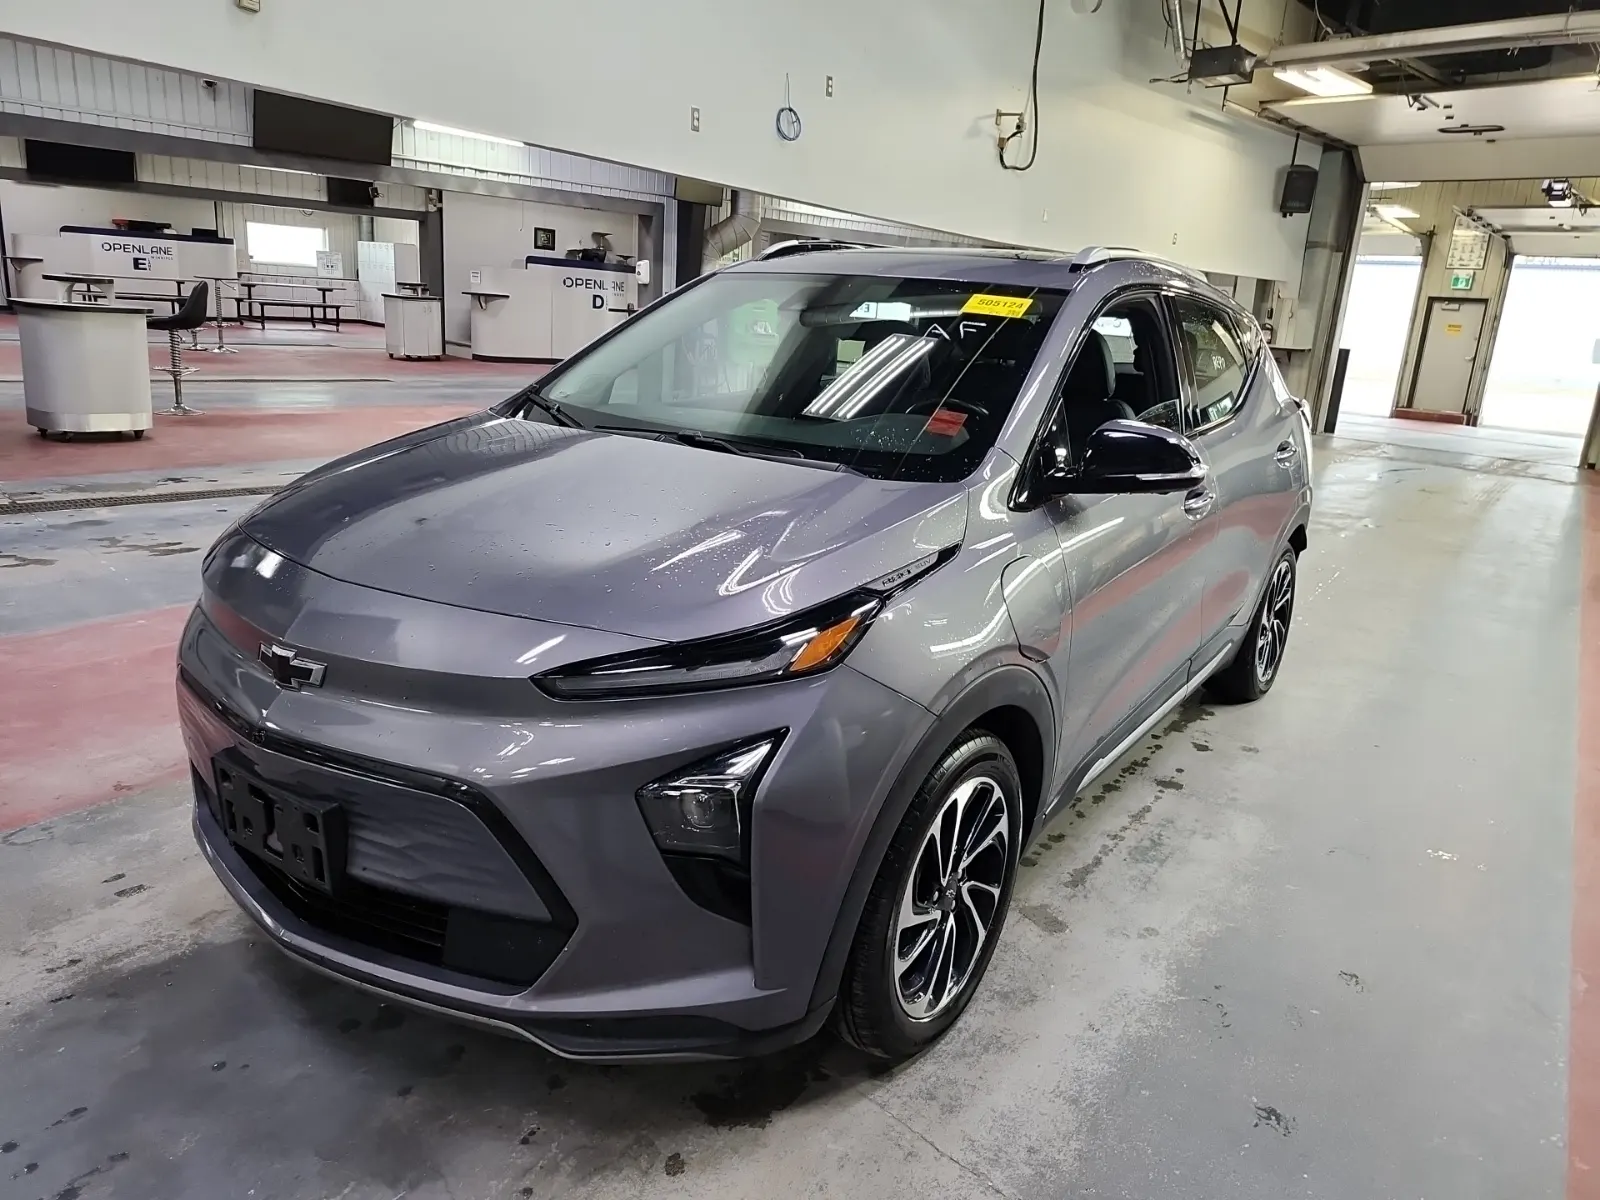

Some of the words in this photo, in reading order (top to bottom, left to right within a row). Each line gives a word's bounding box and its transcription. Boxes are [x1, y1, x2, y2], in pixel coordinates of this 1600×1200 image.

[101, 242, 173, 255] OPENLANE
[133, 257, 147, 271] E
[592, 294, 604, 309] D
[977, 299, 1024, 309] 505124
